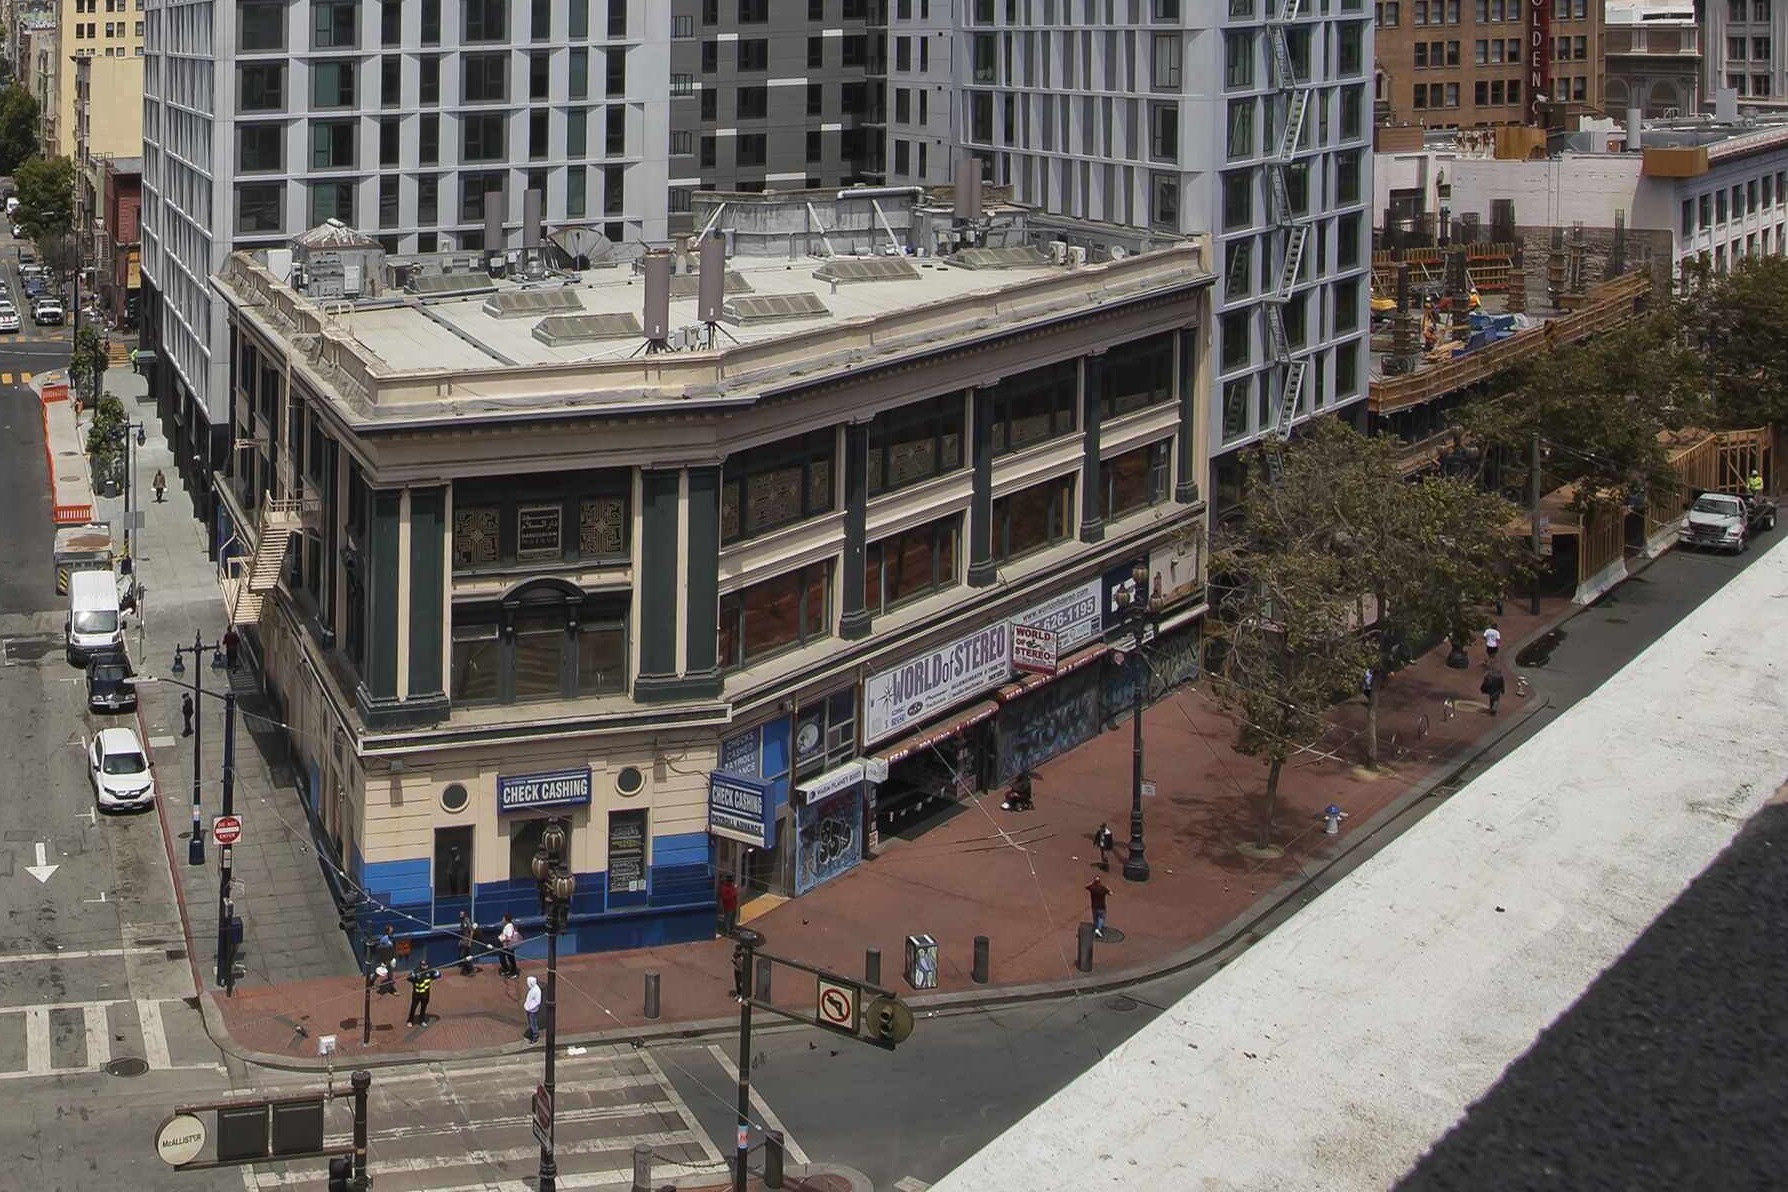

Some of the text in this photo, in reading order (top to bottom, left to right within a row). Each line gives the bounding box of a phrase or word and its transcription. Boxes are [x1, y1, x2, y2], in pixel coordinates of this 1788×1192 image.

[1016, 627, 1051, 641] WORLD
[1015, 638, 1026, 646] OF
[1015, 647, 1050, 661] STEREO
[503, 779, 588, 804] CHECK CASHING
[712, 785, 762, 814] CHECK CASHING
[162, 1133, 201, 1148] McALLISTER
